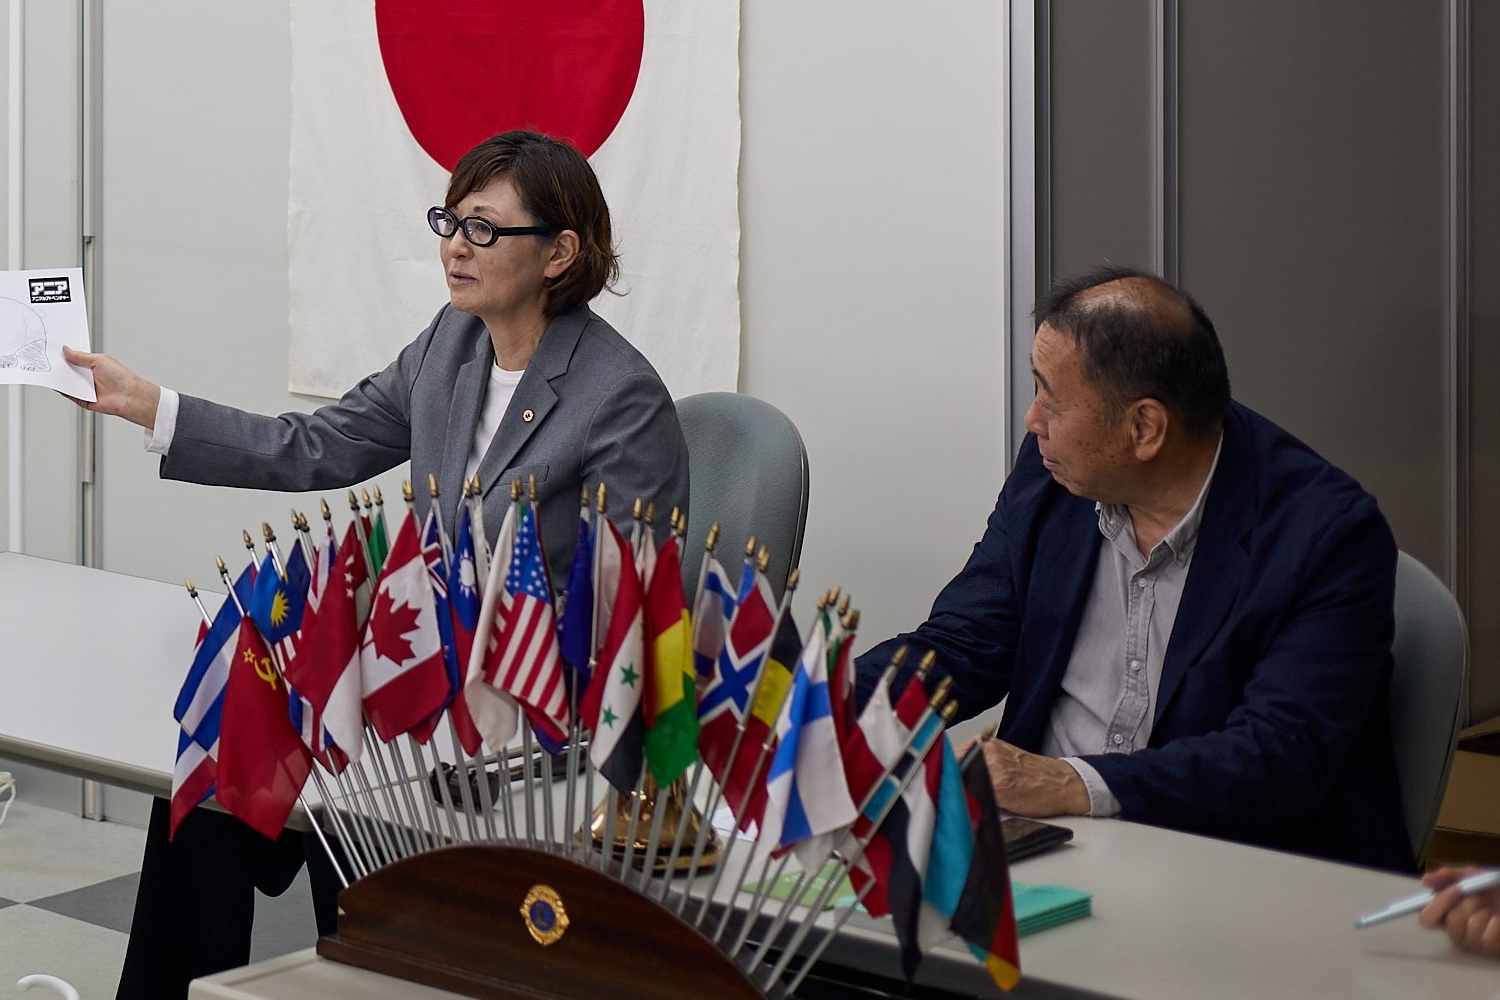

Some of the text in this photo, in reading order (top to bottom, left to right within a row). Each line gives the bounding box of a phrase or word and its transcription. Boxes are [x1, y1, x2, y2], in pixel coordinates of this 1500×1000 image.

[31, 280, 68, 296] アニア
[536, 902, 548, 927] L
